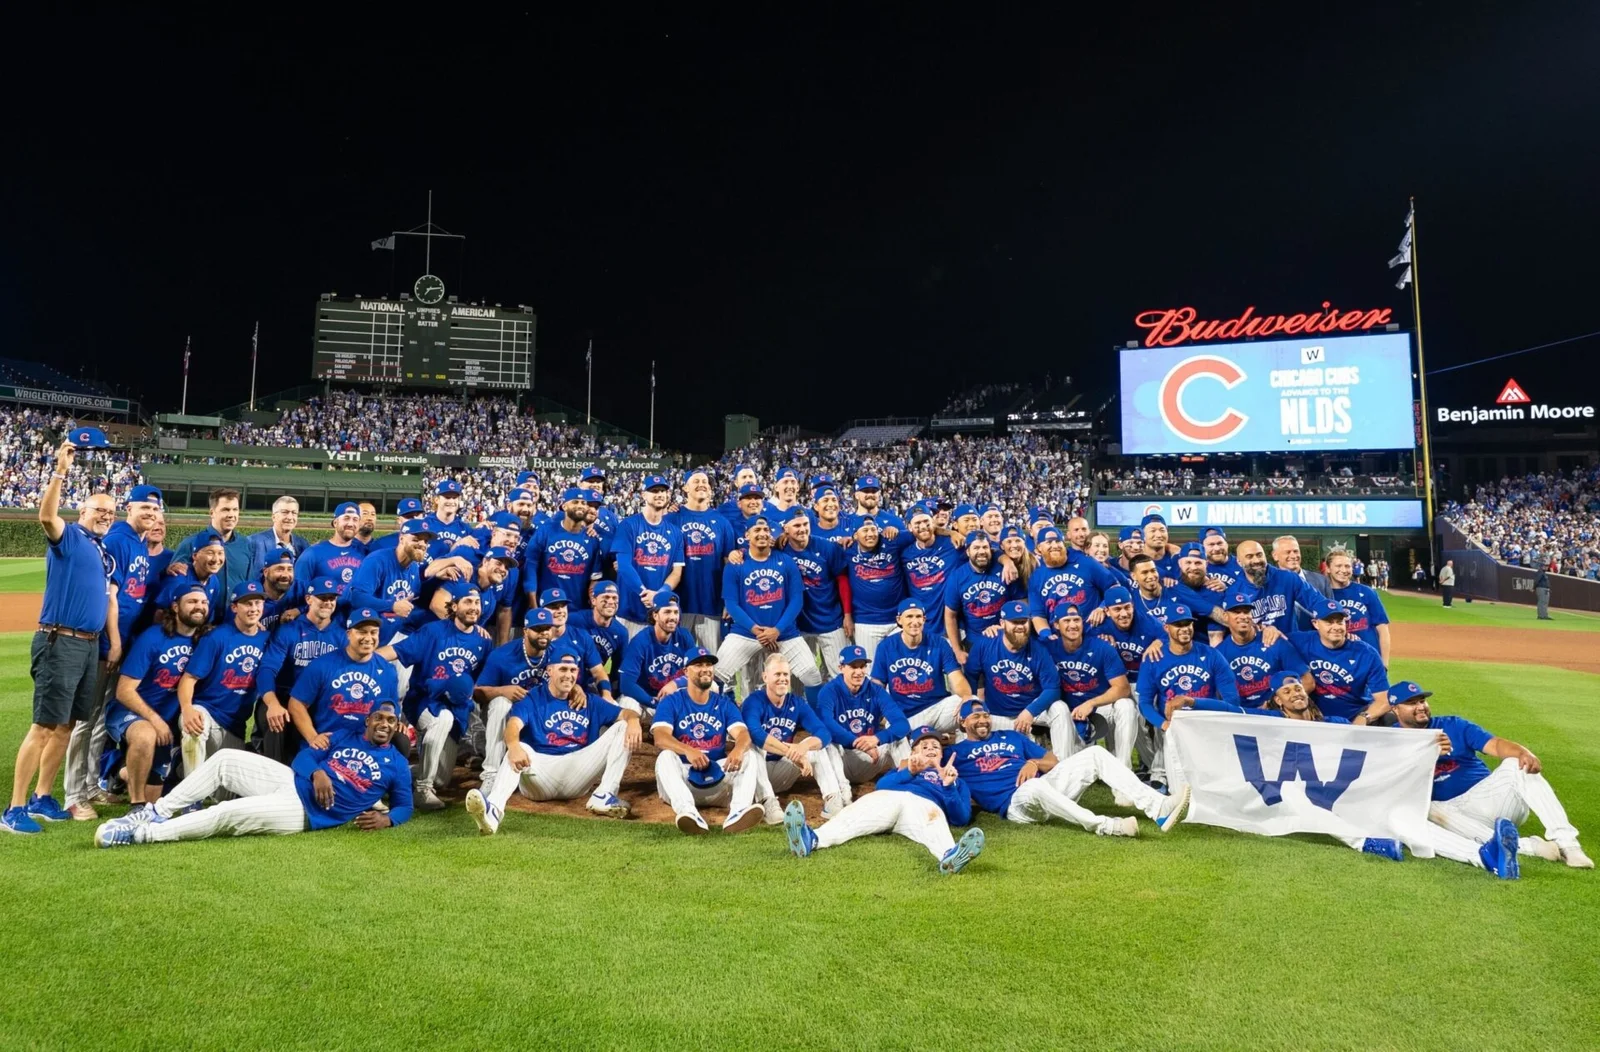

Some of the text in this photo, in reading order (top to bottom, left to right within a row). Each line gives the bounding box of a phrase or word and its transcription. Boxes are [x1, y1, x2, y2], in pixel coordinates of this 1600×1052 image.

[360, 301, 406, 312] NATIONAL
[451, 307, 496, 318] AMERICAN
[1135, 301, 1392, 348] Budweiser
[1306, 349, 1319, 360] W
[1280, 395, 1352, 435] NLDS
[1438, 404, 1594, 424] Benjamin Moore
[326, 450, 361, 461] YETI
[533, 458, 594, 469] Budweiser
[619, 459, 659, 469] Advocate
[1177, 507, 1192, 520] W
[1206, 504, 1270, 524] ADVANCE
[1274, 504, 1292, 524] TO
[1296, 504, 1324, 524] THE
[1326, 504, 1367, 524] NLDS
[548, 540, 589, 561] OCTOBER
[636, 531, 671, 551] OCTOBER
[547, 556, 586, 574] Baseball
[744, 569, 784, 586] OCTOBER
[1041, 573, 1084, 597] OCTOBER
[746, 588, 783, 607] Baseball
[963, 581, 1006, 600] OCTOBER
[889, 658, 933, 676] OCTOBER
[1230, 656, 1271, 673] CTOBER
[1310, 660, 1354, 683] CTOBER
[332, 672, 381, 697] OCTOBER
[892, 677, 934, 694] Baseball
[1160, 664, 1210, 688] OCTOBER
[545, 711, 590, 729] OCTOBER
[679, 712, 722, 731] OCTOBER
[333, 748, 380, 781] OCTOBER
[1233, 734, 1368, 812] W
